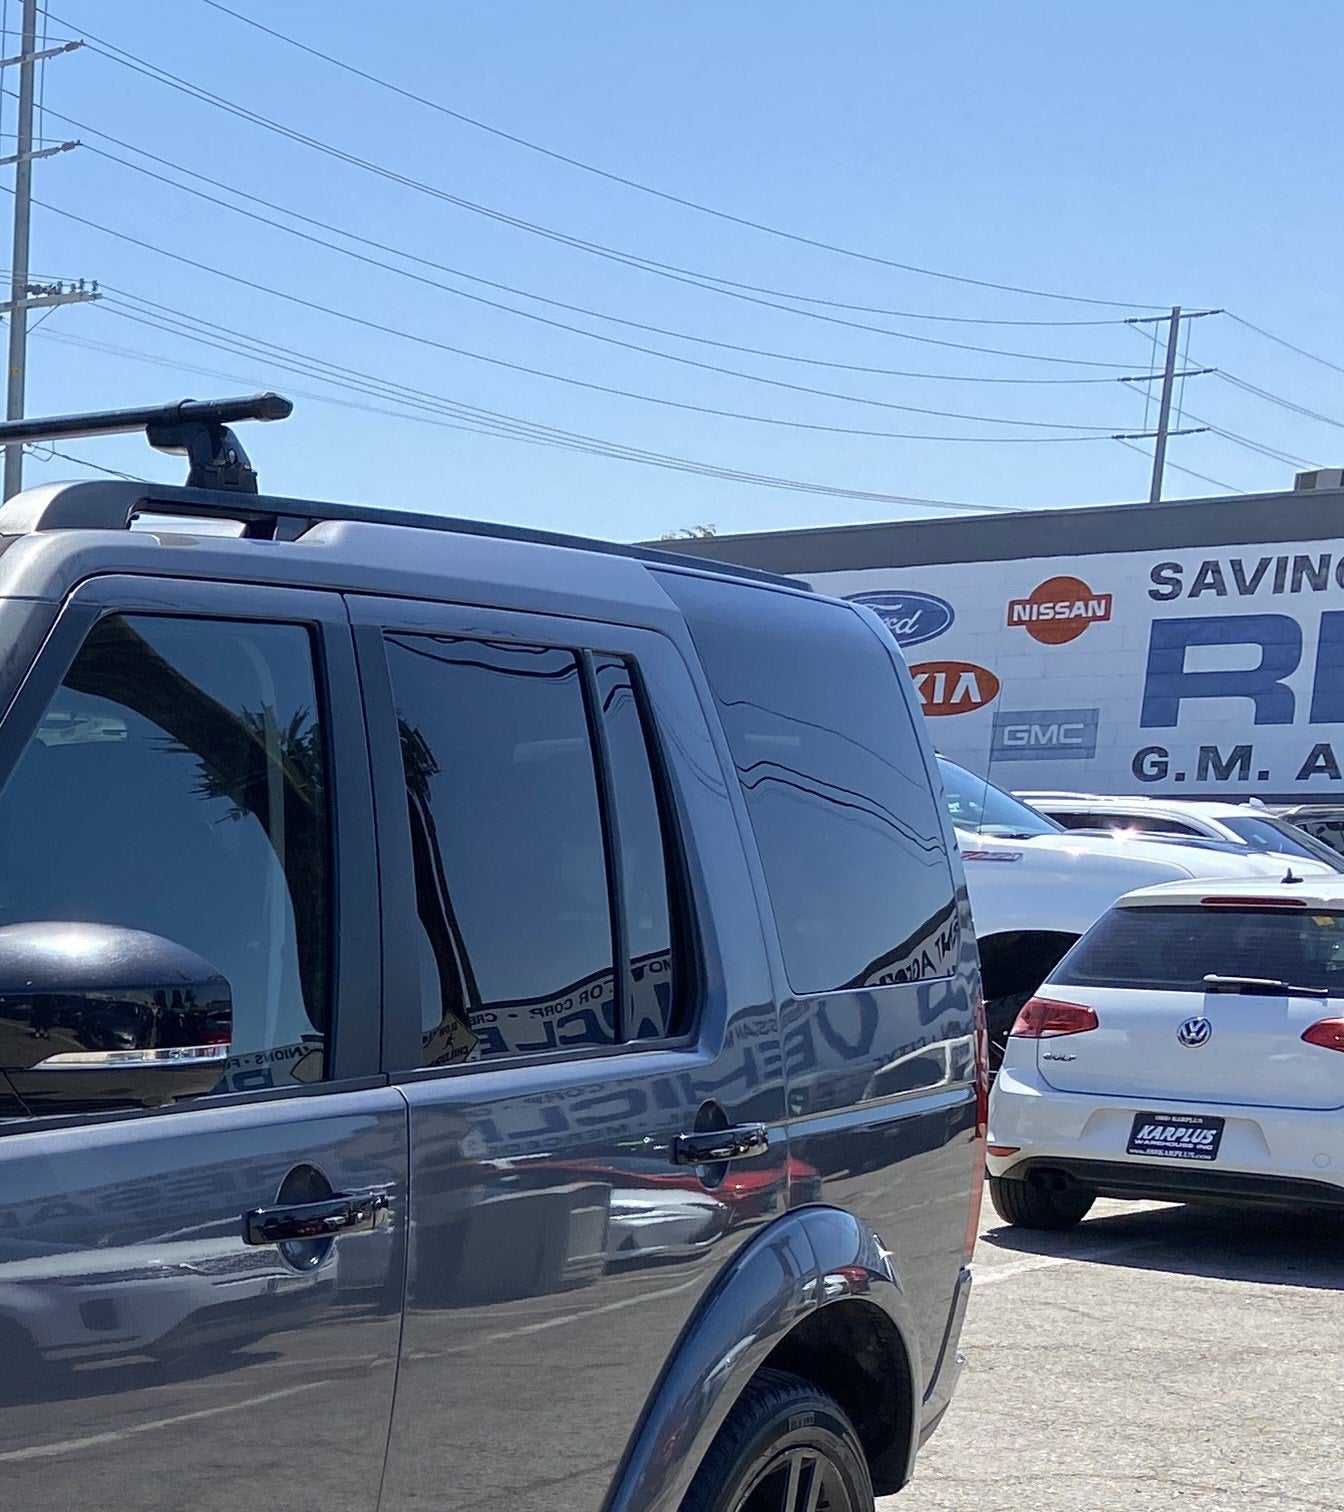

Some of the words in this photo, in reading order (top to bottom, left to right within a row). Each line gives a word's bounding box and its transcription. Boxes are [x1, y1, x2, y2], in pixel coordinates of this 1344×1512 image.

[1012, 598, 1106, 622] NISSAN
[1140, 611, 1344, 728] R
[1003, 723, 1084, 746] GMC
[1132, 744, 1270, 782] G.M.
[1134, 1139, 1194, 1149] WAREHOUSE
[1137, 1125, 1217, 1144] KARPLUS
